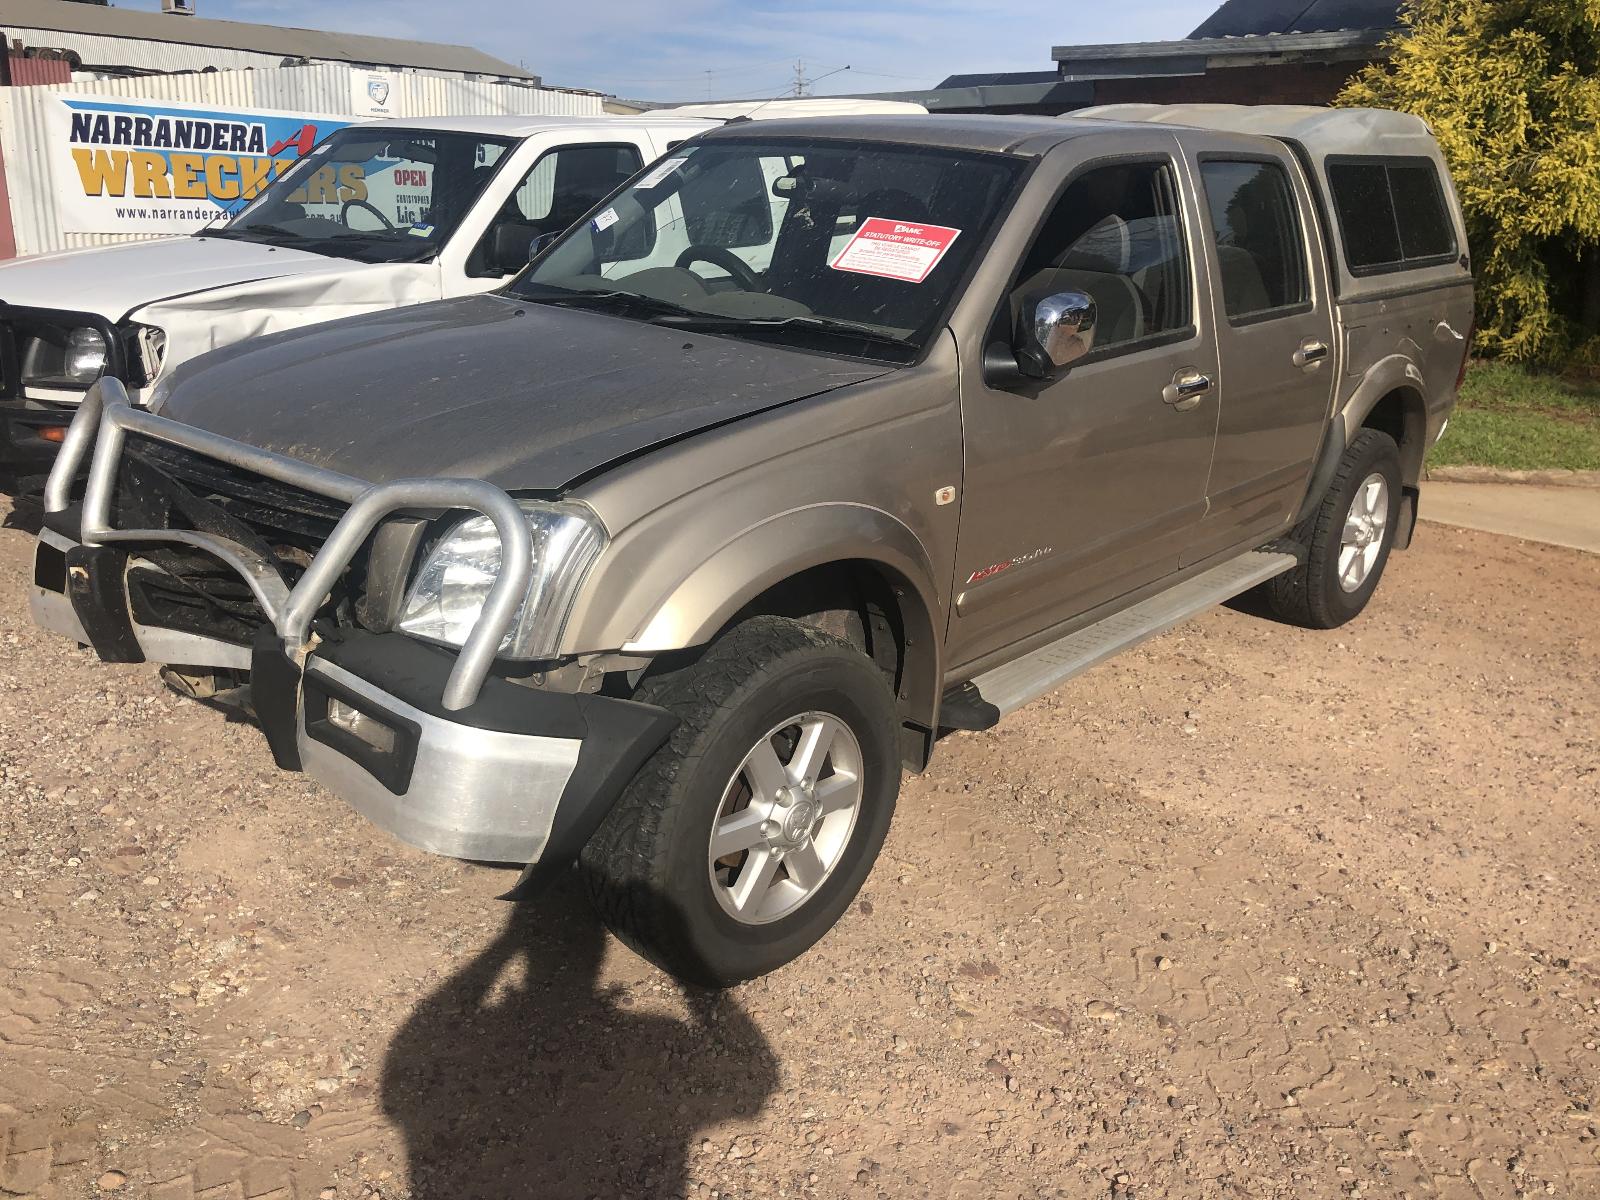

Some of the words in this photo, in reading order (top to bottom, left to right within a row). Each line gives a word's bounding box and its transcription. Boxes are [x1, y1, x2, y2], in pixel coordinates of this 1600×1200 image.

[70, 112, 266, 153] NARRANDERA
[393, 169, 427, 187] OPEN
[396, 205, 416, 224] Lic
[863, 231, 902, 242] STATUTORY
[903, 236, 942, 247] WRITE-OFF
